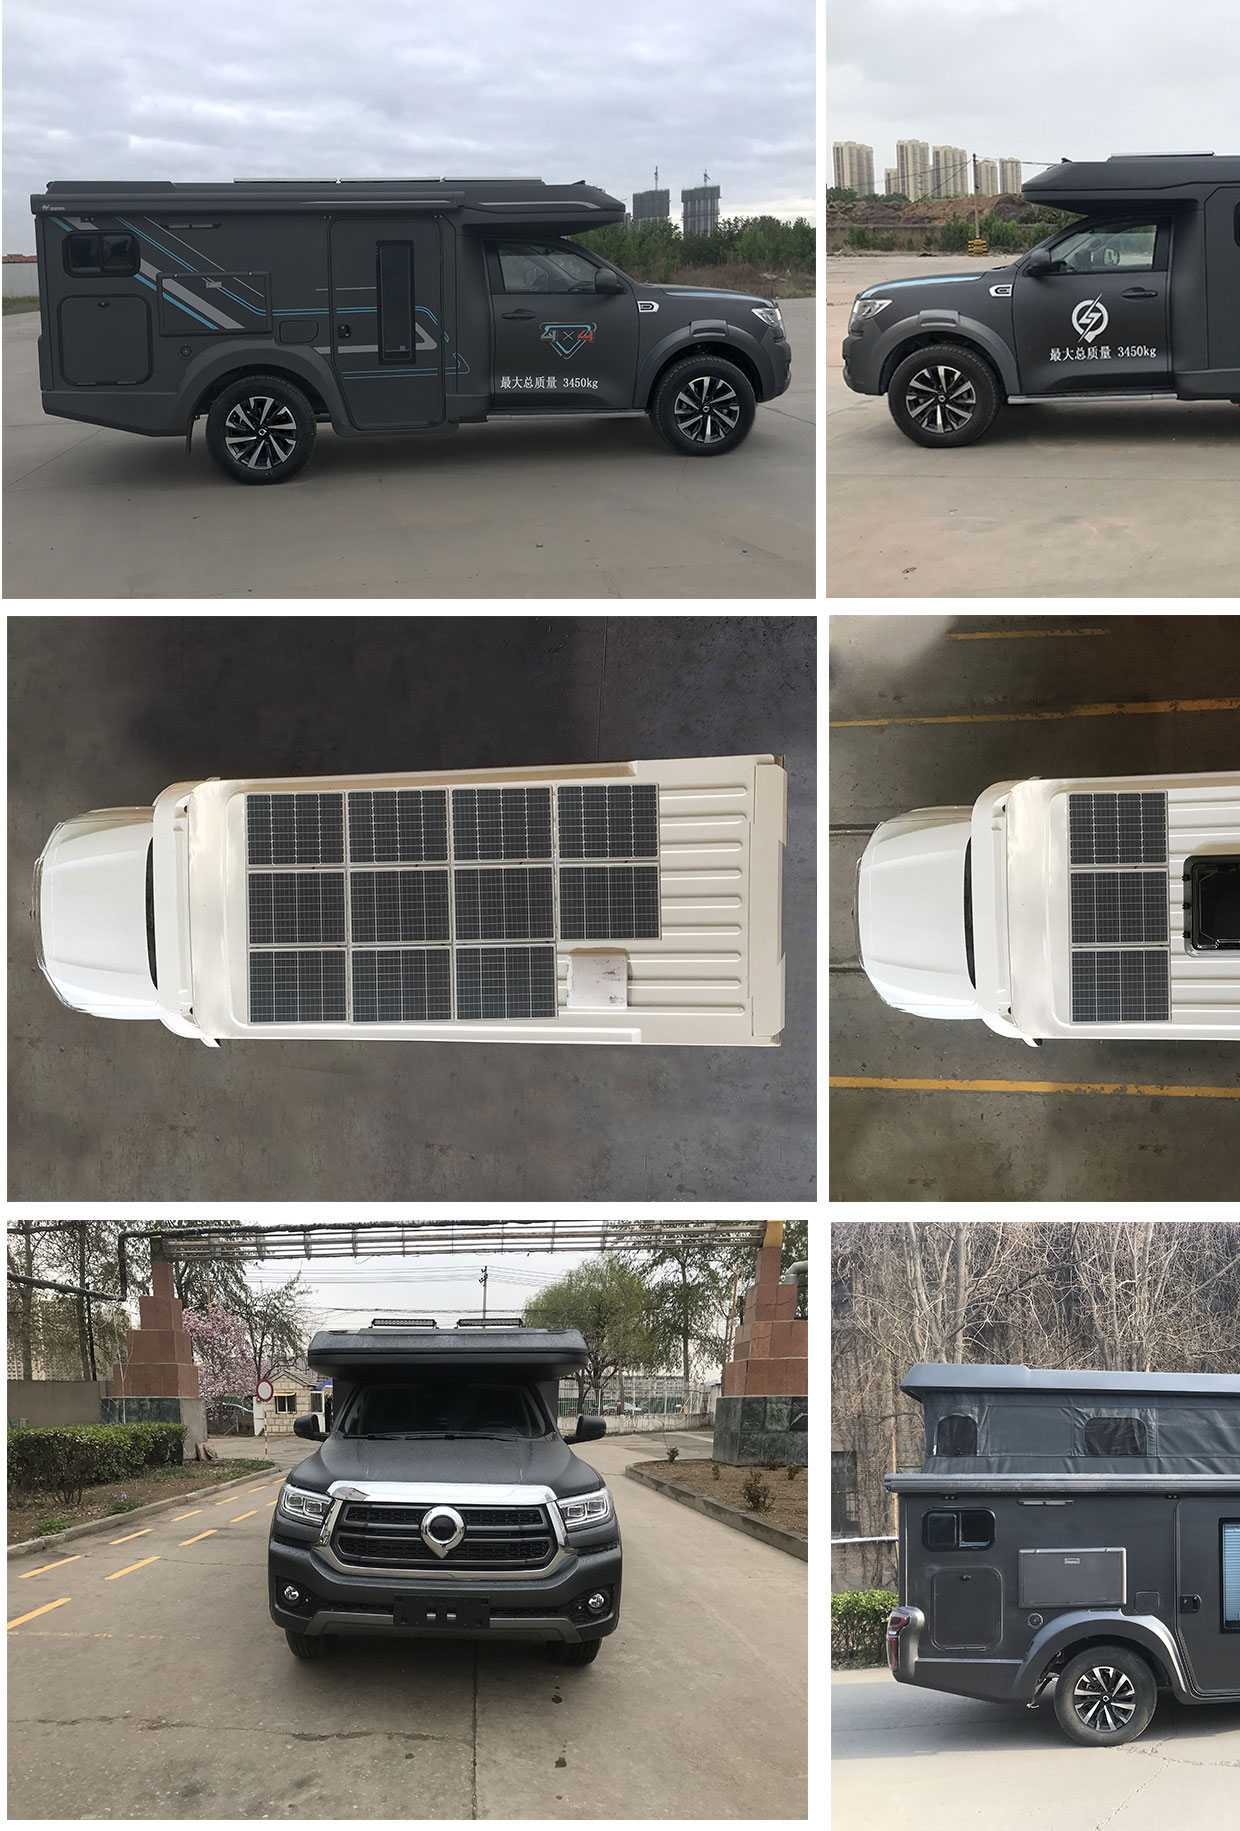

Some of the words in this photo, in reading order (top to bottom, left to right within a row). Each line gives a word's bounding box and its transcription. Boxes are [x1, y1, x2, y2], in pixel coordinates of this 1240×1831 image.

[1049, 345, 1112, 362] 最大总质量
[1117, 345, 1157, 359] 3450kg
[500, 376, 558, 389] 最大总质量
[563, 377, 599, 390] 3450kg
